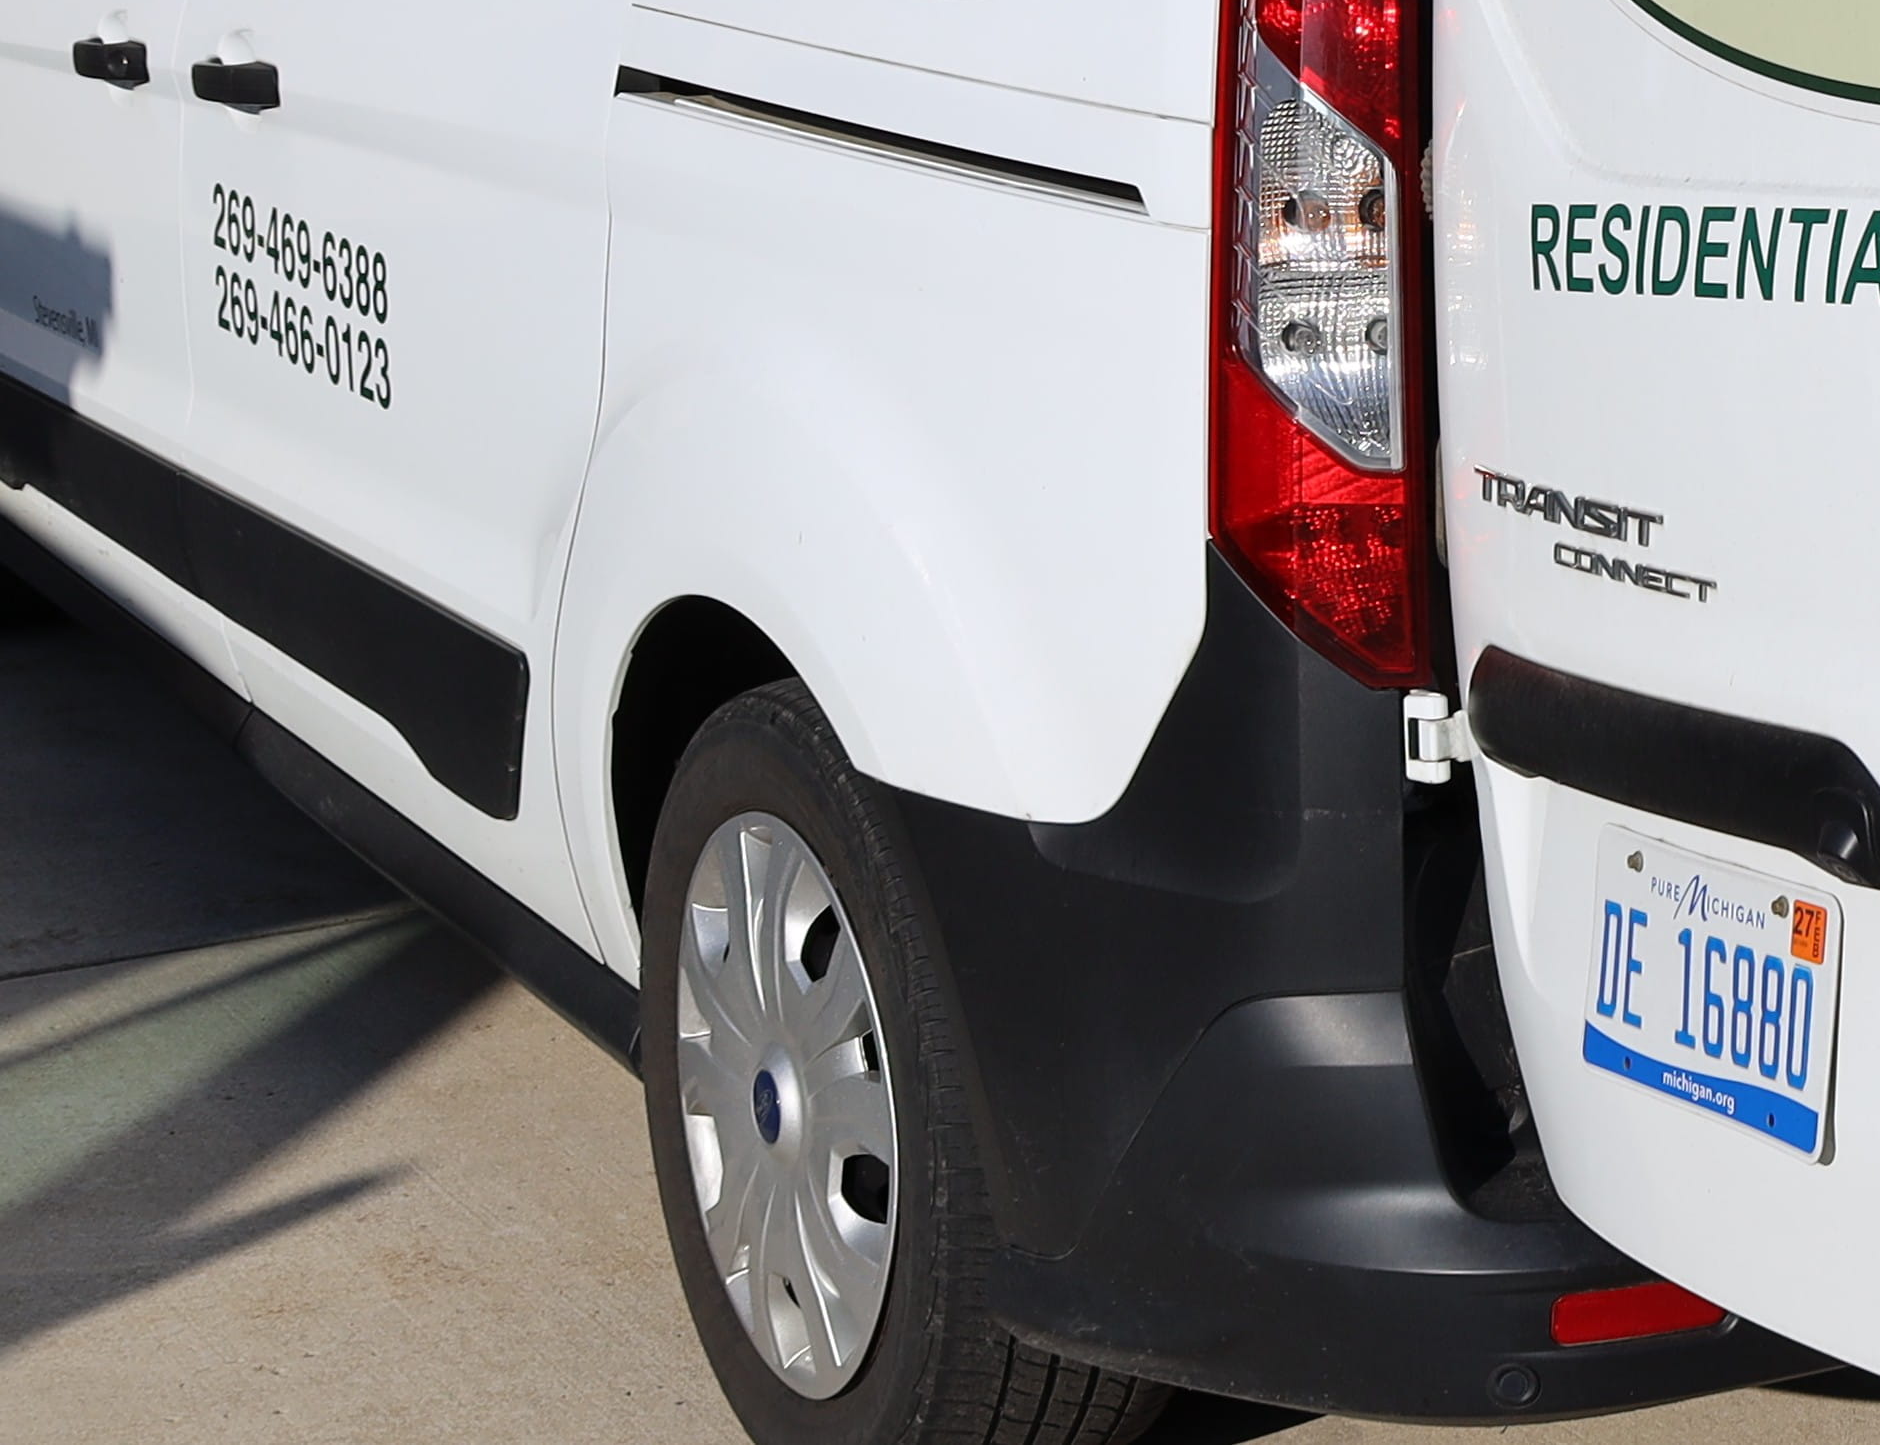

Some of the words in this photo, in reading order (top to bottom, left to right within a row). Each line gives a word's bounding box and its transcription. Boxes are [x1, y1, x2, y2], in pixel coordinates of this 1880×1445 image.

[212, 183, 388, 325] 269-469-6388
[214, 266, 391, 411] 269-466-0123
[1473, 464, 1664, 548] TRANSIT
[1553, 543, 1718, 603] CONNECT
[1651, 876, 1680, 902] PURE
[1673, 874, 1766, 929] MICHIGAN
[1793, 905, 1814, 936] 27
[1812, 910, 1822, 958] FEB
[1596, 899, 1648, 1029] DE
[1675, 927, 1814, 1091] 16880
[1662, 1070, 1736, 1115] michigan.org
